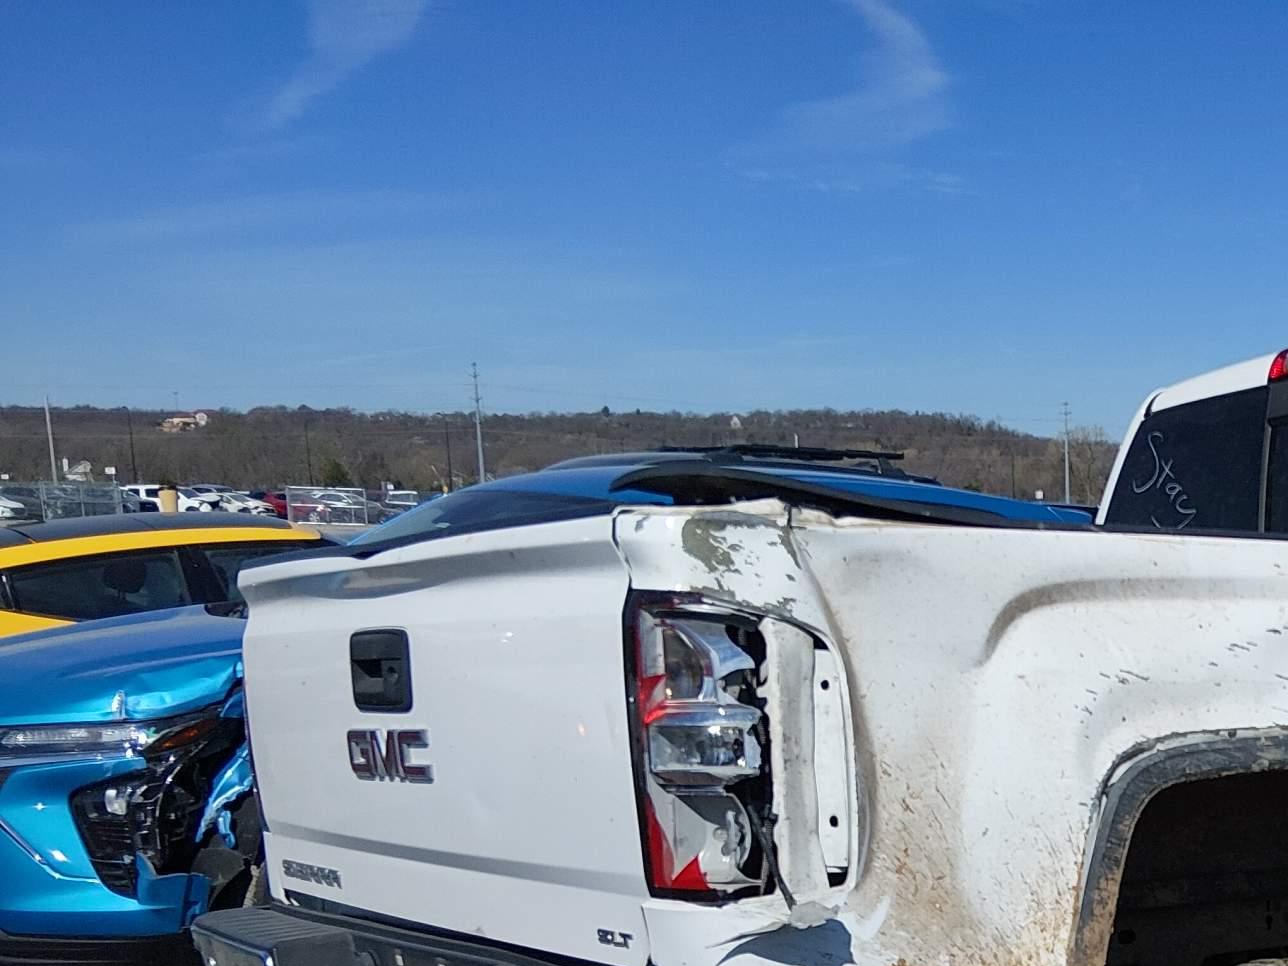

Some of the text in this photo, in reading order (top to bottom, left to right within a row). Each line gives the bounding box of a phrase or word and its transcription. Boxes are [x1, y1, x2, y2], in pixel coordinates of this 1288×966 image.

[347, 729, 434, 784] GMC
[282, 859, 342, 889] SIERRA
[597, 928, 633, 949] SLT
